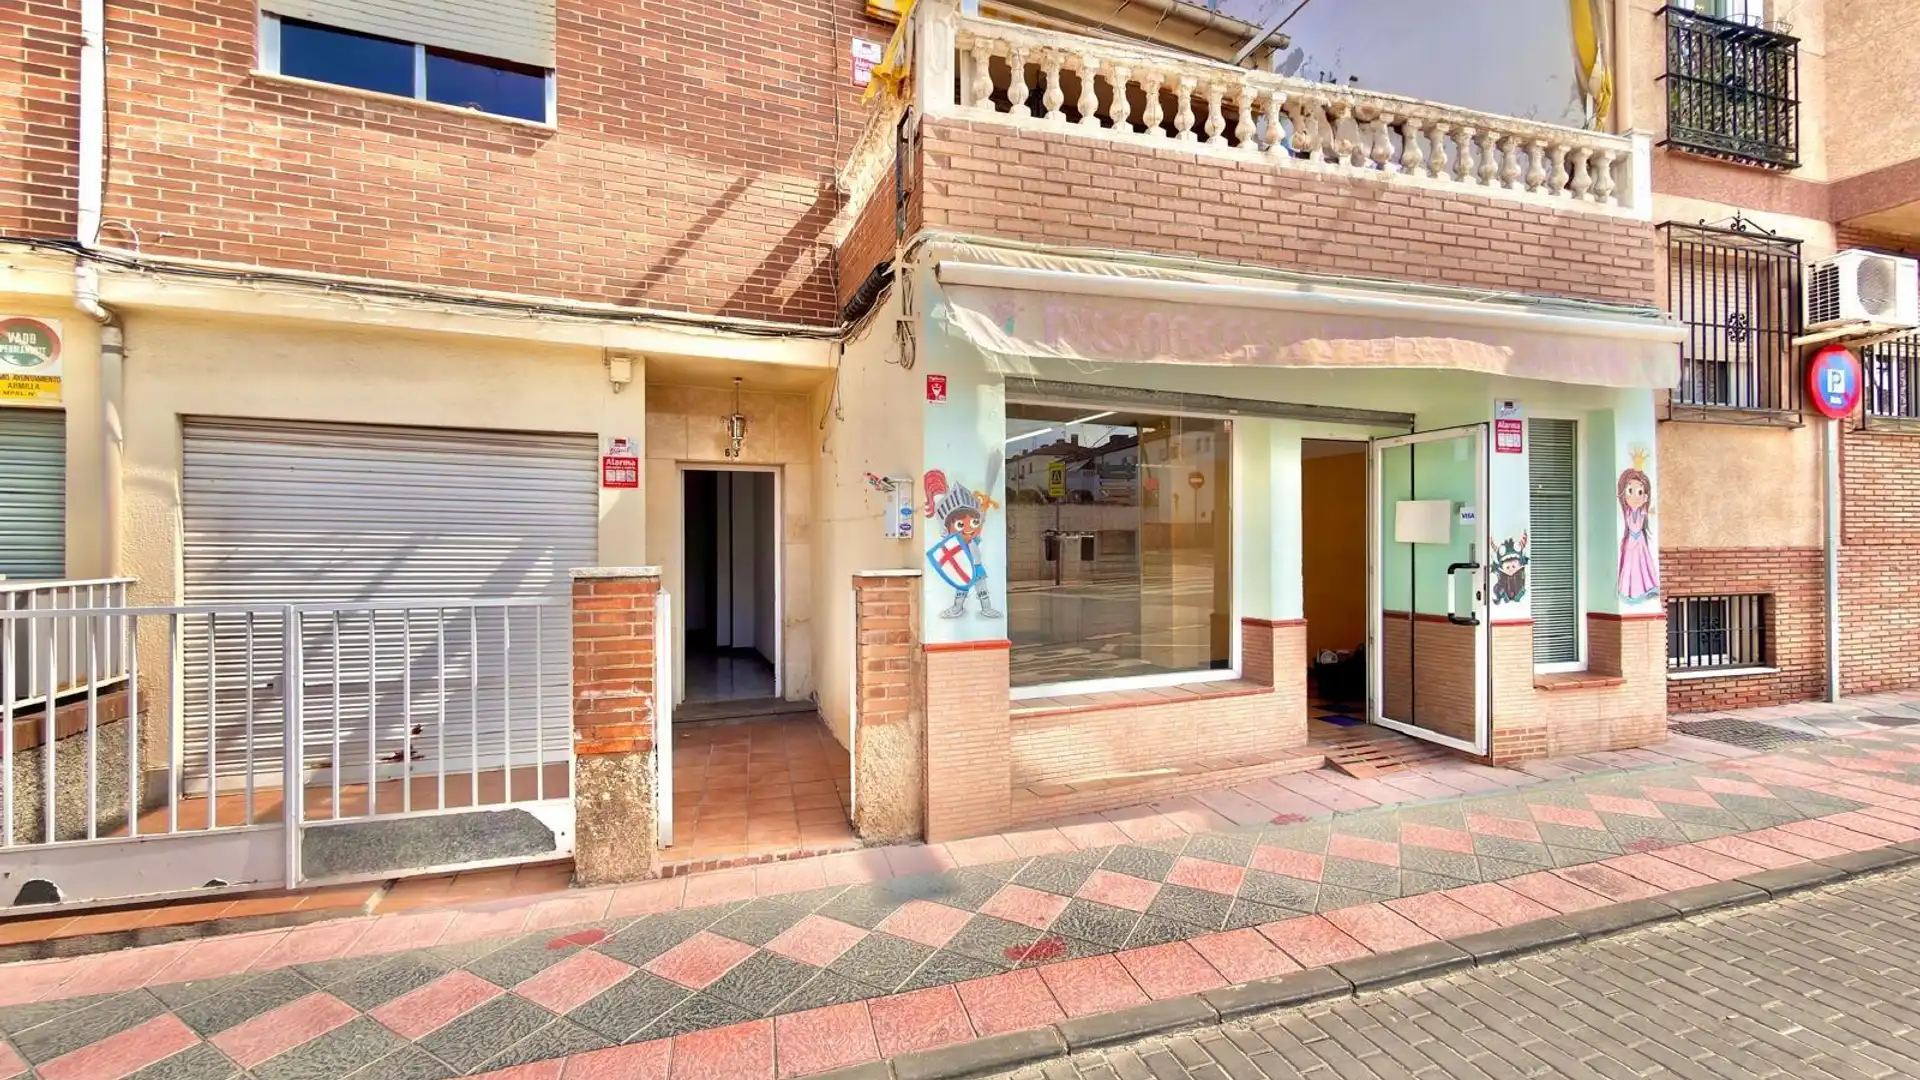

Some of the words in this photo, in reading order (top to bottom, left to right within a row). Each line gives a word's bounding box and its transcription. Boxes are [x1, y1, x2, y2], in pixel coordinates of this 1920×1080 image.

[7, 332, 37, 345] VADO
[1498, 421, 1521, 430] Alarma
[605, 458, 636, 467] Alarma
